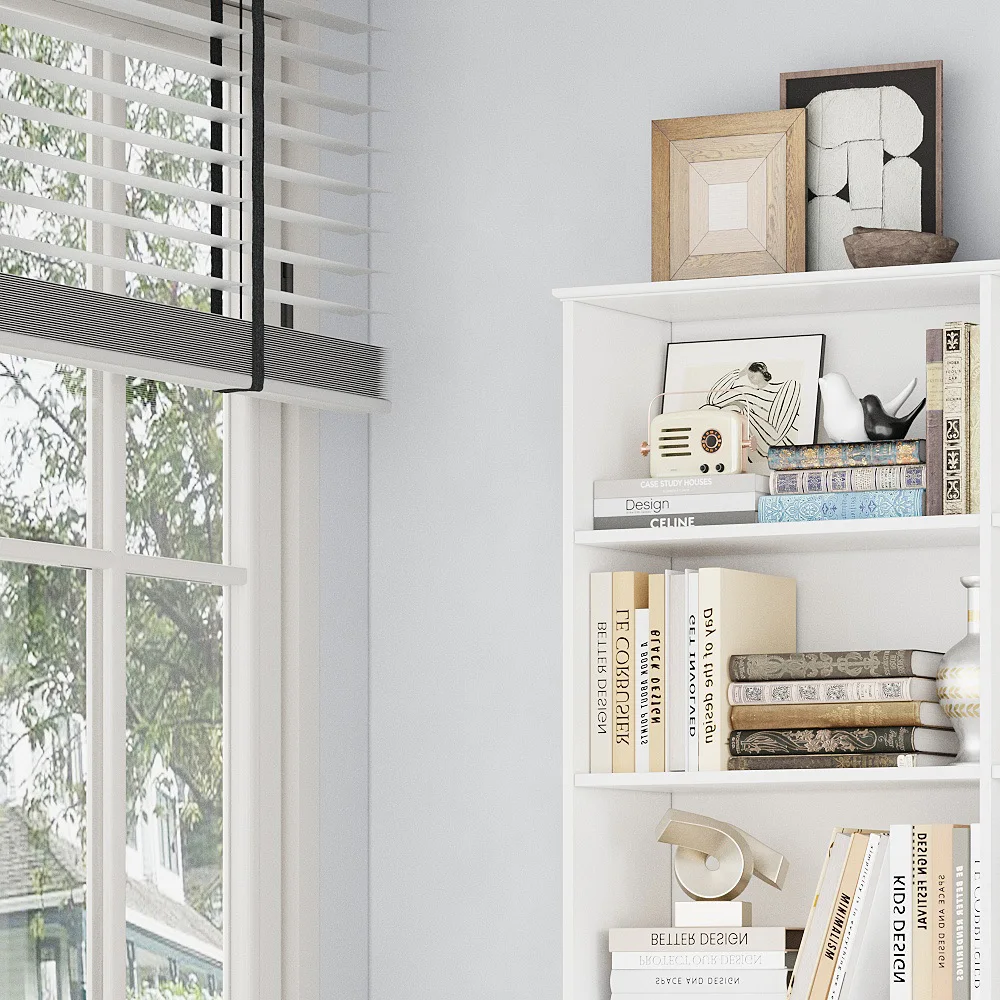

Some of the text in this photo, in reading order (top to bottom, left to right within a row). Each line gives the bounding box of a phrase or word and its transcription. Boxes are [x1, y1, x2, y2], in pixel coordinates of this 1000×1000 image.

[640, 477, 713, 489] CASE STUDY HOUSES
[625, 498, 670, 514] Design
[650, 516, 695, 529] CELINE
[825, 892, 850, 960] MINIMALISM
